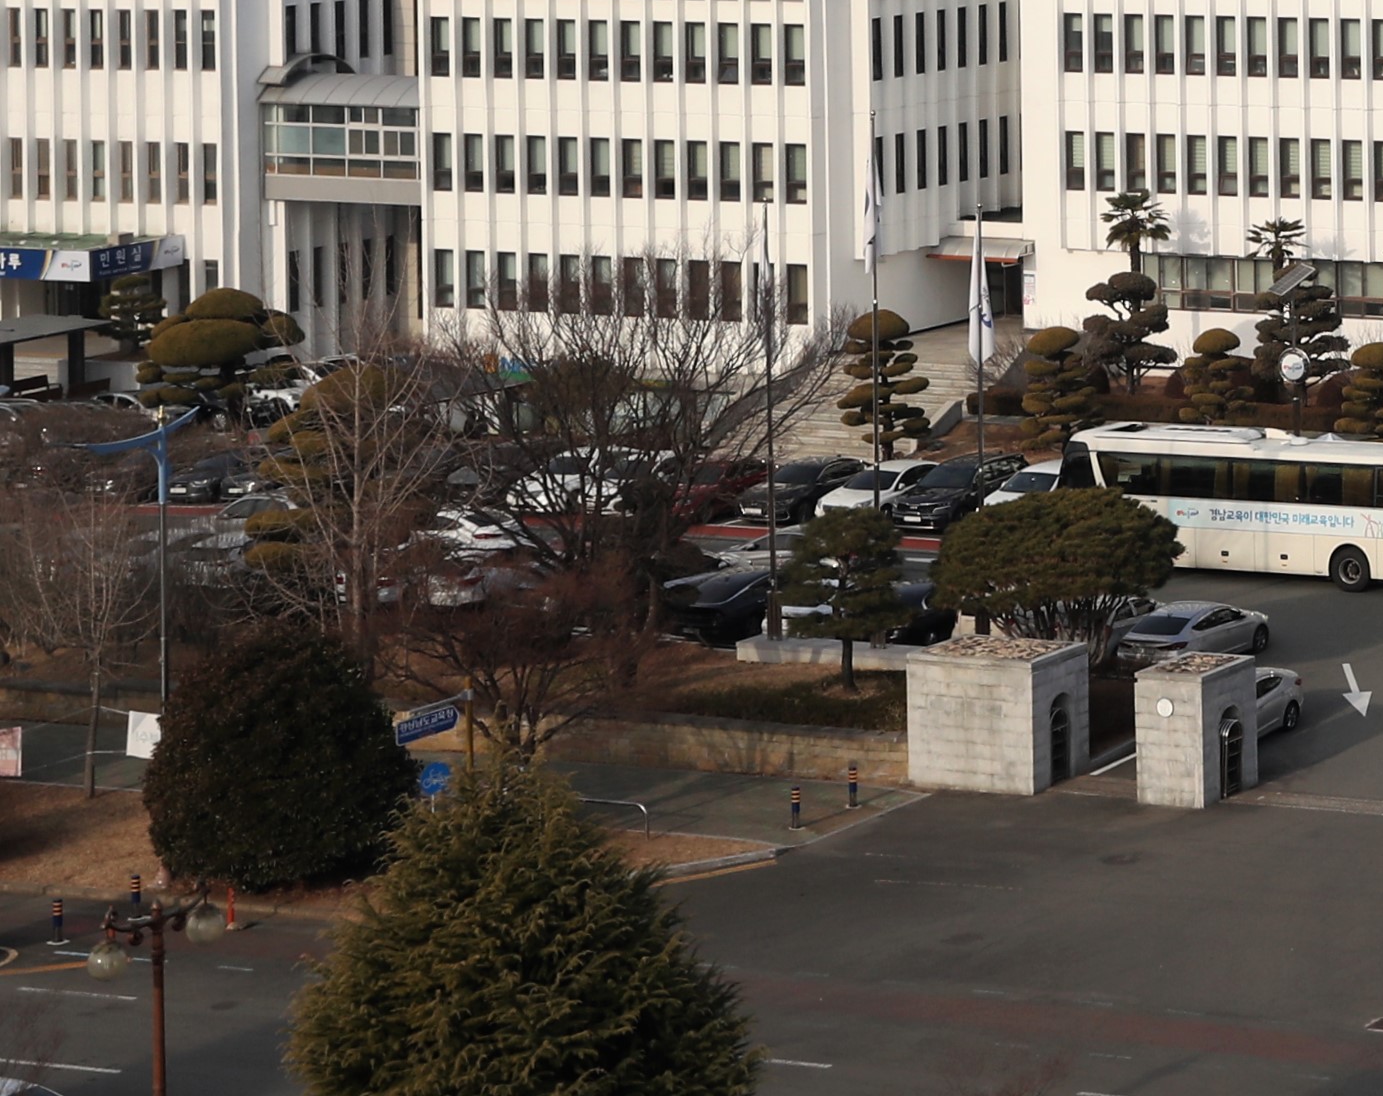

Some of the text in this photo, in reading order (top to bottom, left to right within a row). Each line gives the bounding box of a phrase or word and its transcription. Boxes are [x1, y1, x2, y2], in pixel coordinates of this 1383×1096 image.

[1209, 508, 1253, 523] 경남교육이
[1254, 510, 1290, 526] 대한민국
[1291, 512, 1355, 529] 미래교육입니다
